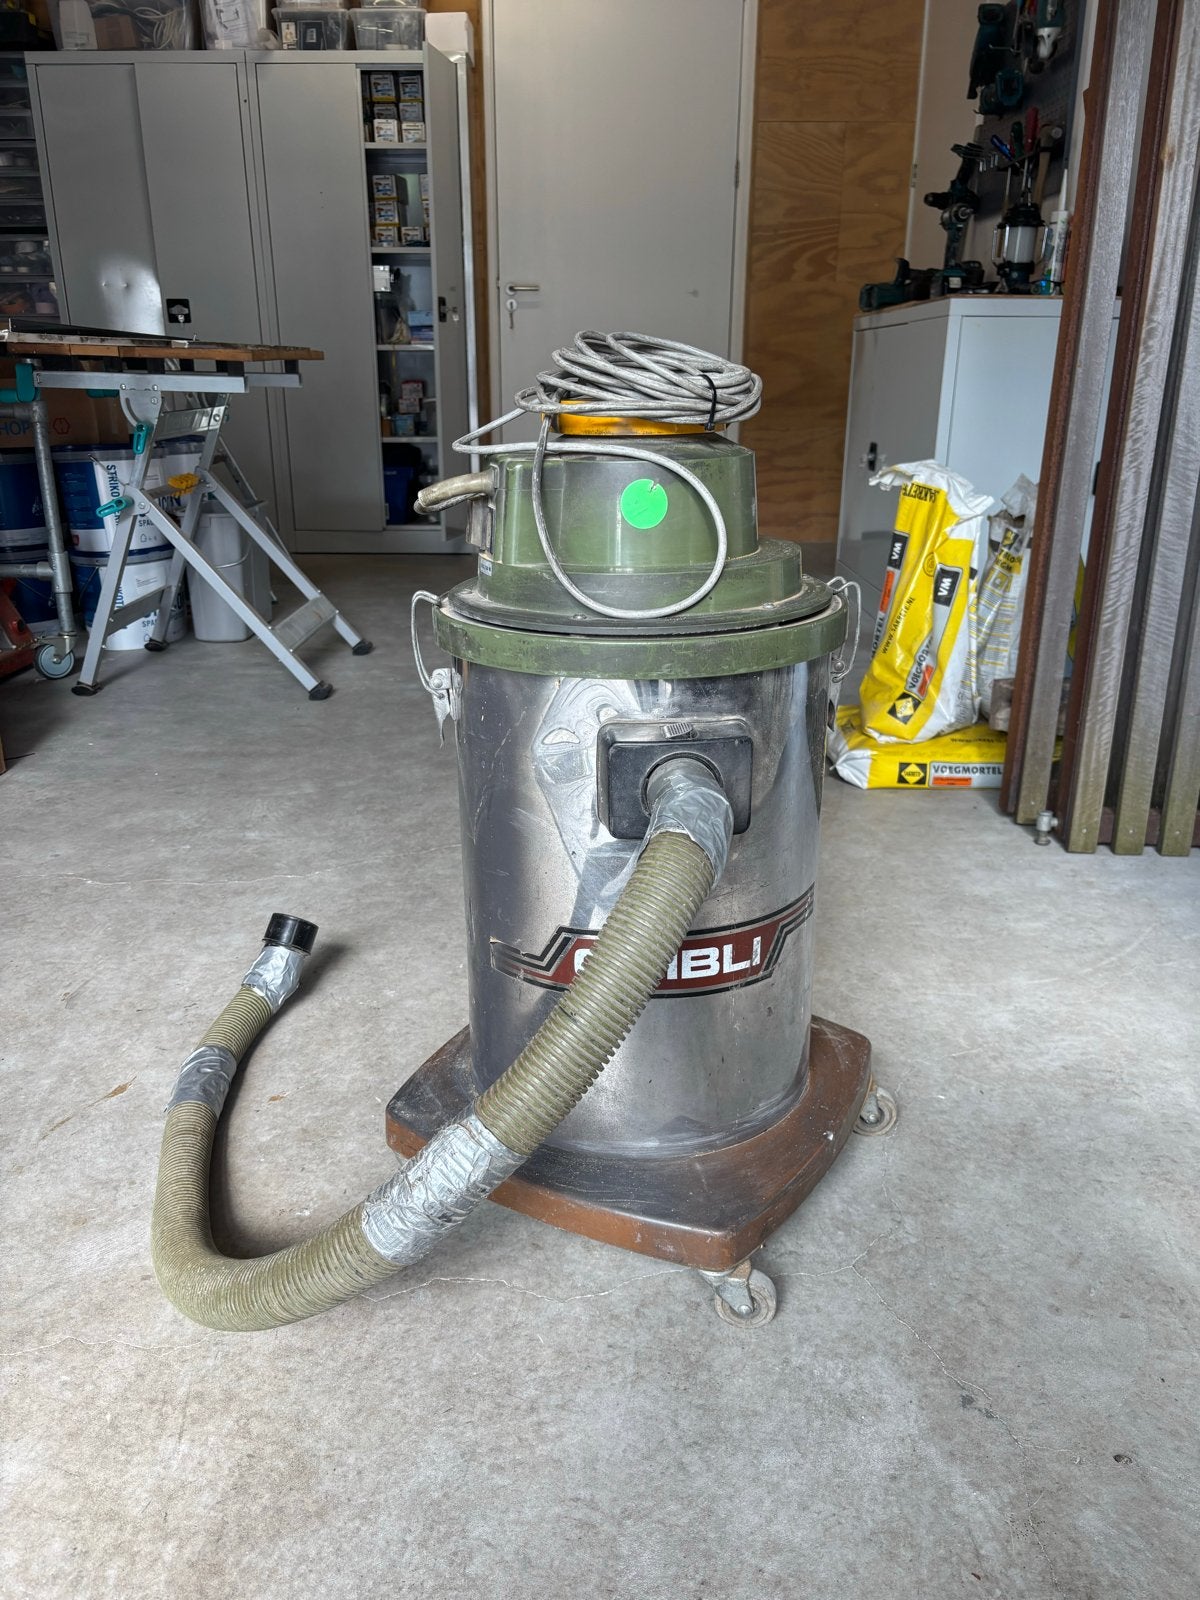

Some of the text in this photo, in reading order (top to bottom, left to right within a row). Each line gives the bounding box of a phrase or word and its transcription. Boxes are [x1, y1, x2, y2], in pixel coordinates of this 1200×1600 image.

[891, 542, 903, 560] VM
[937, 577, 953, 596] VM
[932, 764, 1003, 775] VOEGMORTEL
